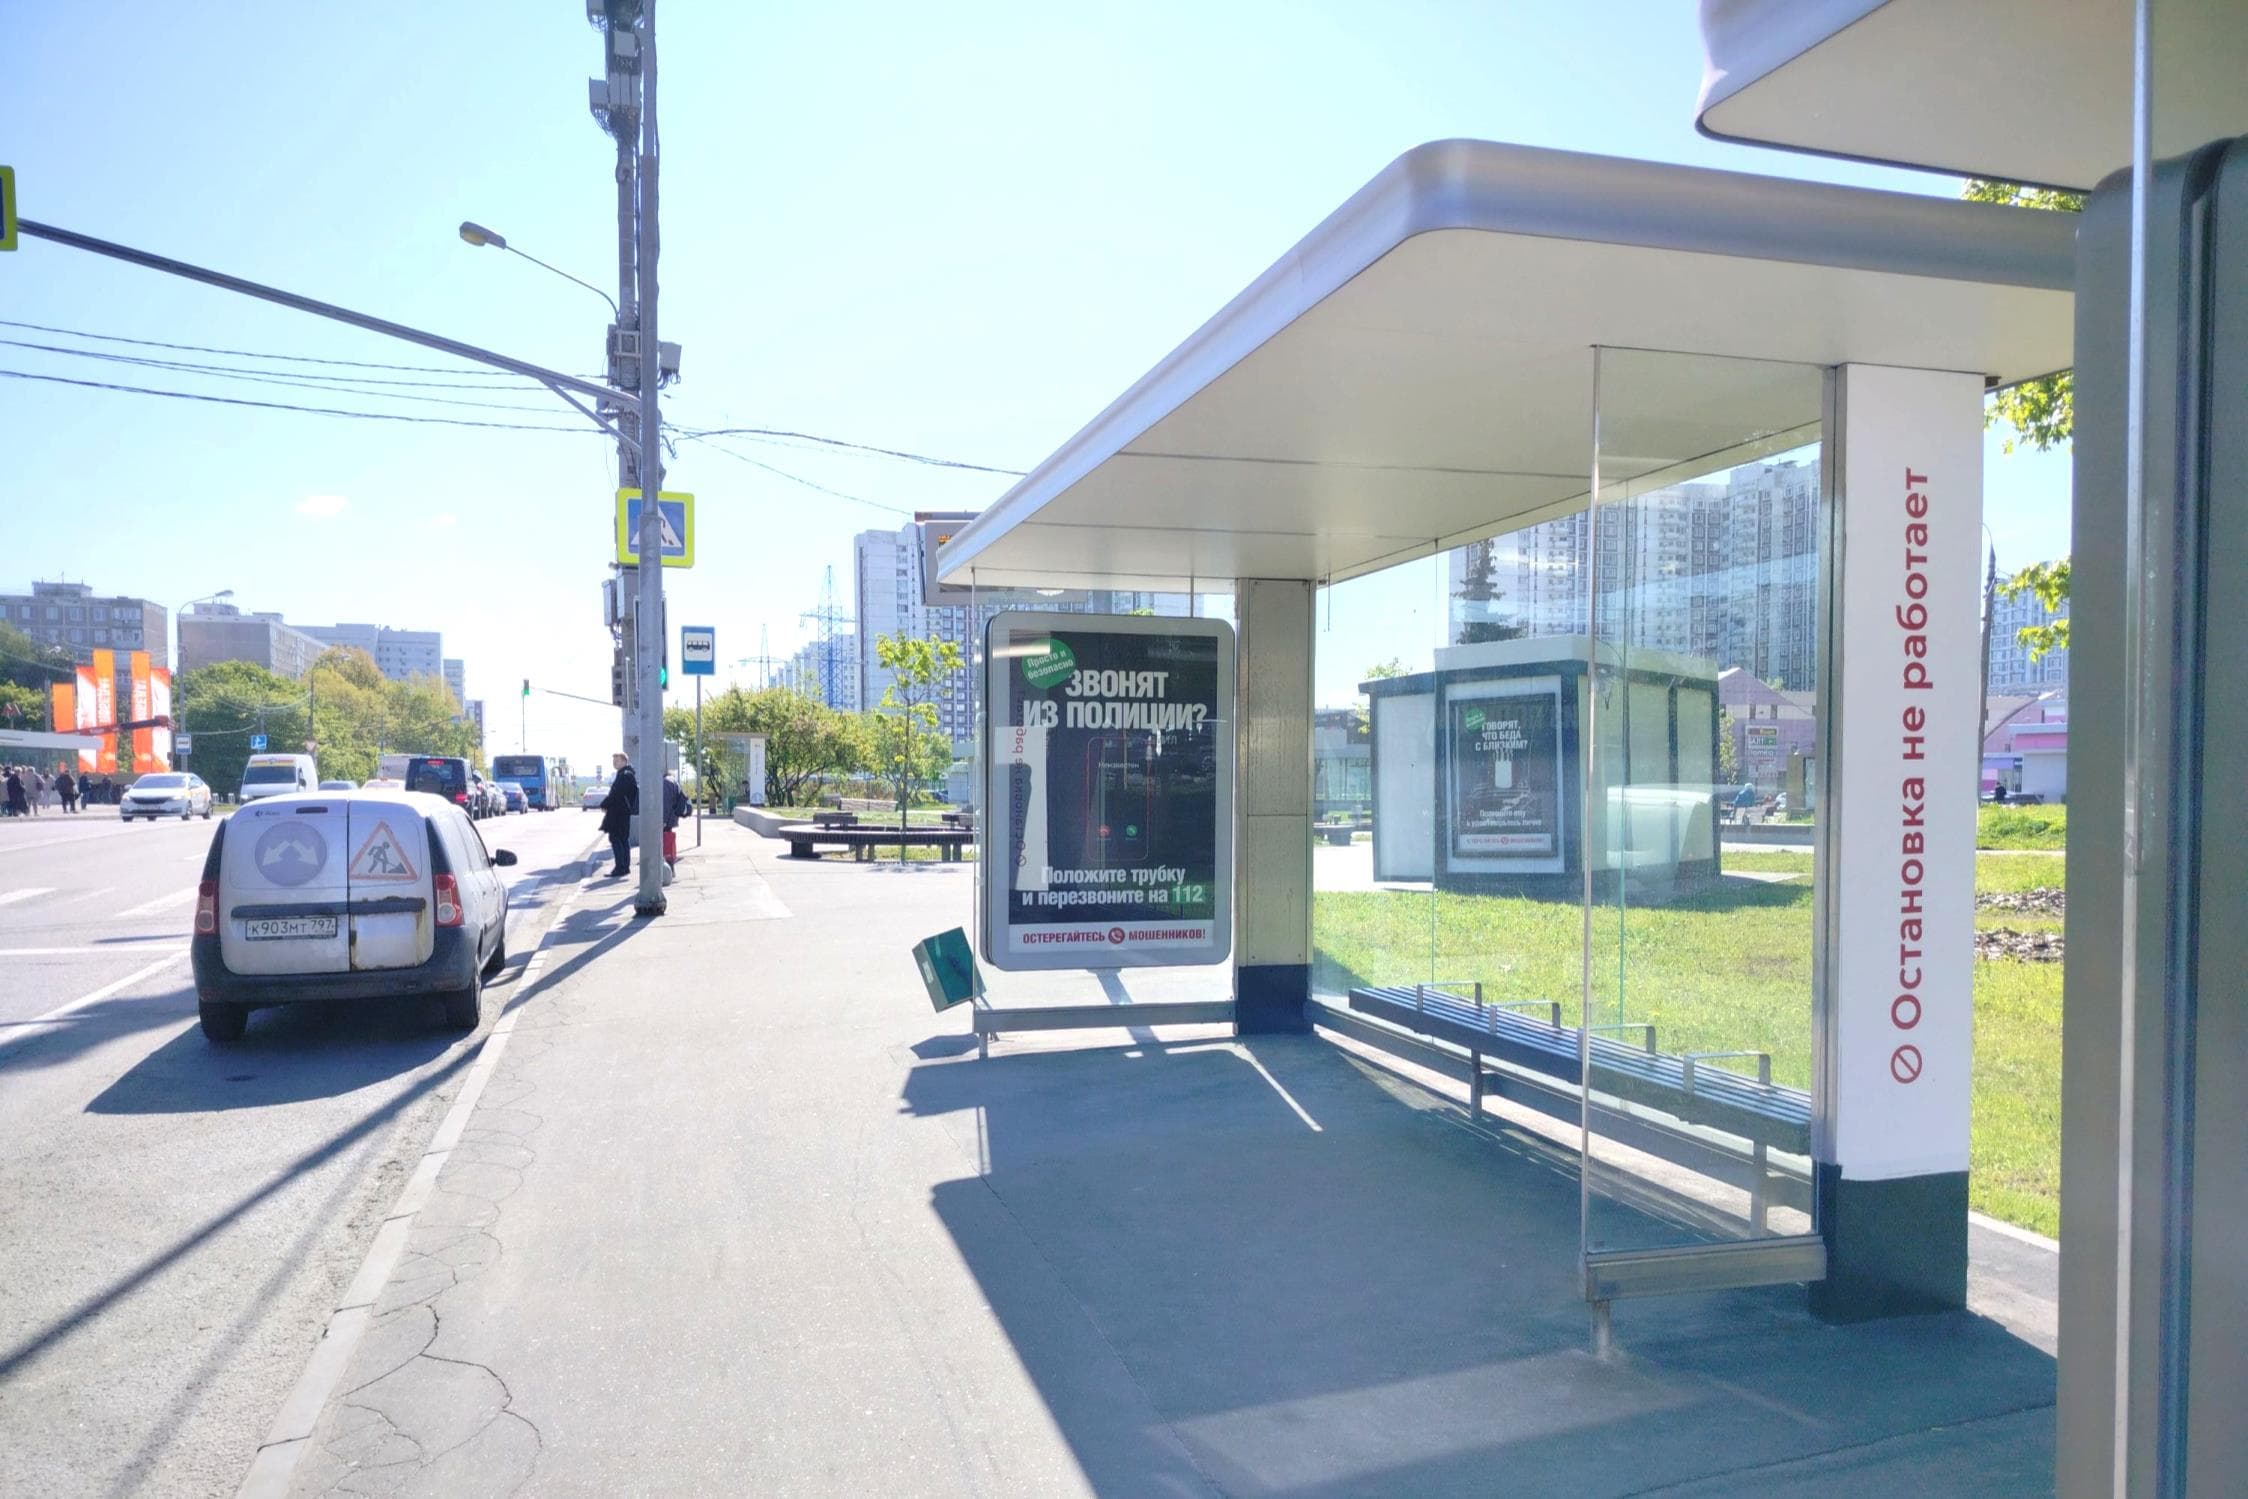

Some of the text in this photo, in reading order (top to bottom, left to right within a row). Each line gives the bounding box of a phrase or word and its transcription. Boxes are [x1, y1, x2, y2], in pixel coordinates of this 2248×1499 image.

[1027, 649, 1067, 668] Просто и
[1028, 659, 1074, 680] безопасно
[1065, 669, 1169, 698] ЗВОНЯТ
[1023, 700, 1208, 733] ИЗ ПОЛИЦИИ?
[1481, 730, 1522, 741] ЧТО БЕДА
[1475, 742, 1482, 752] С
[1891, 466, 1933, 1030] Остановка не работает
[1041, 865, 1186, 886] Положите трубку
[1022, 885, 1204, 909] и перезвоните на 112
[251, 919, 332, 935] К903МТ 797
[1022, 928, 1207, 945] ОСТЕРЕГАЙТЕСЬ МОШЕННИКОВ!
